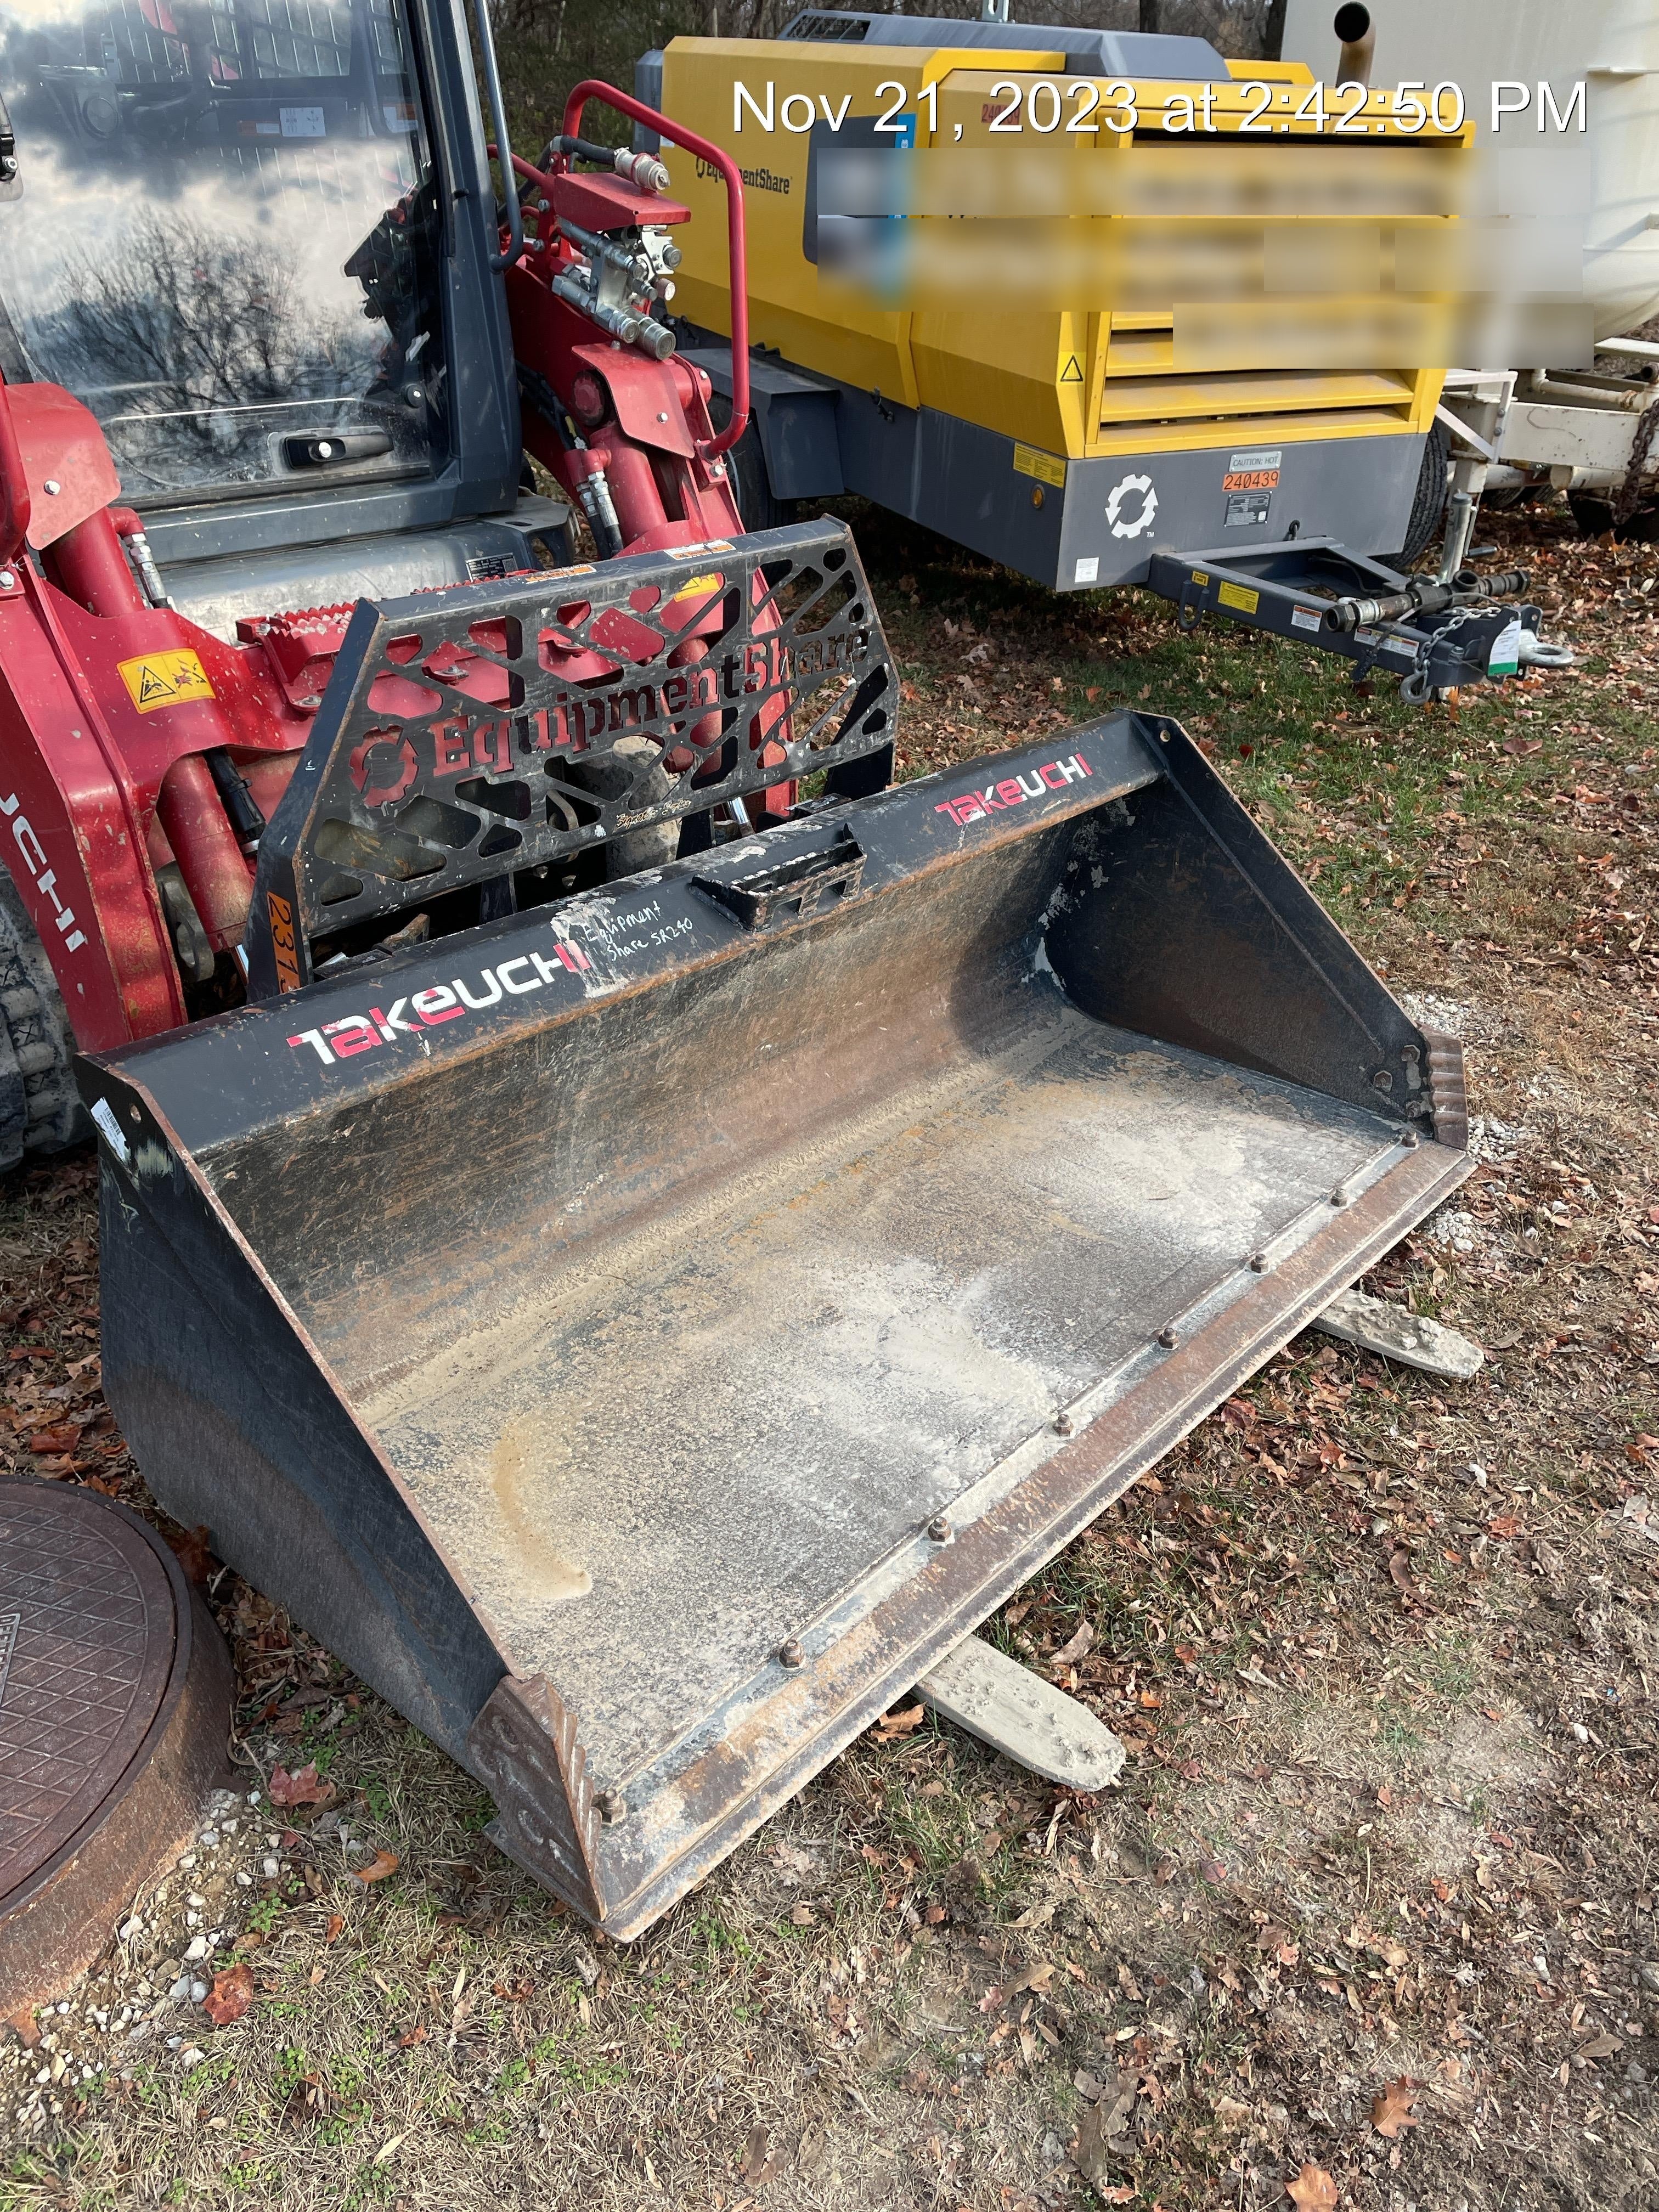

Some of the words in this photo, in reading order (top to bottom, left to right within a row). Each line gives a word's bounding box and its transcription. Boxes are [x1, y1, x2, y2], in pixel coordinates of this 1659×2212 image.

[1233, 458, 1263, 467] CAUTION:
[1265, 456, 1279, 464] HOT
[1224, 471, 1279, 490] 240439
[433, 629, 868, 777] EquipmentShare
[582, 900, 662, 944] Equipment
